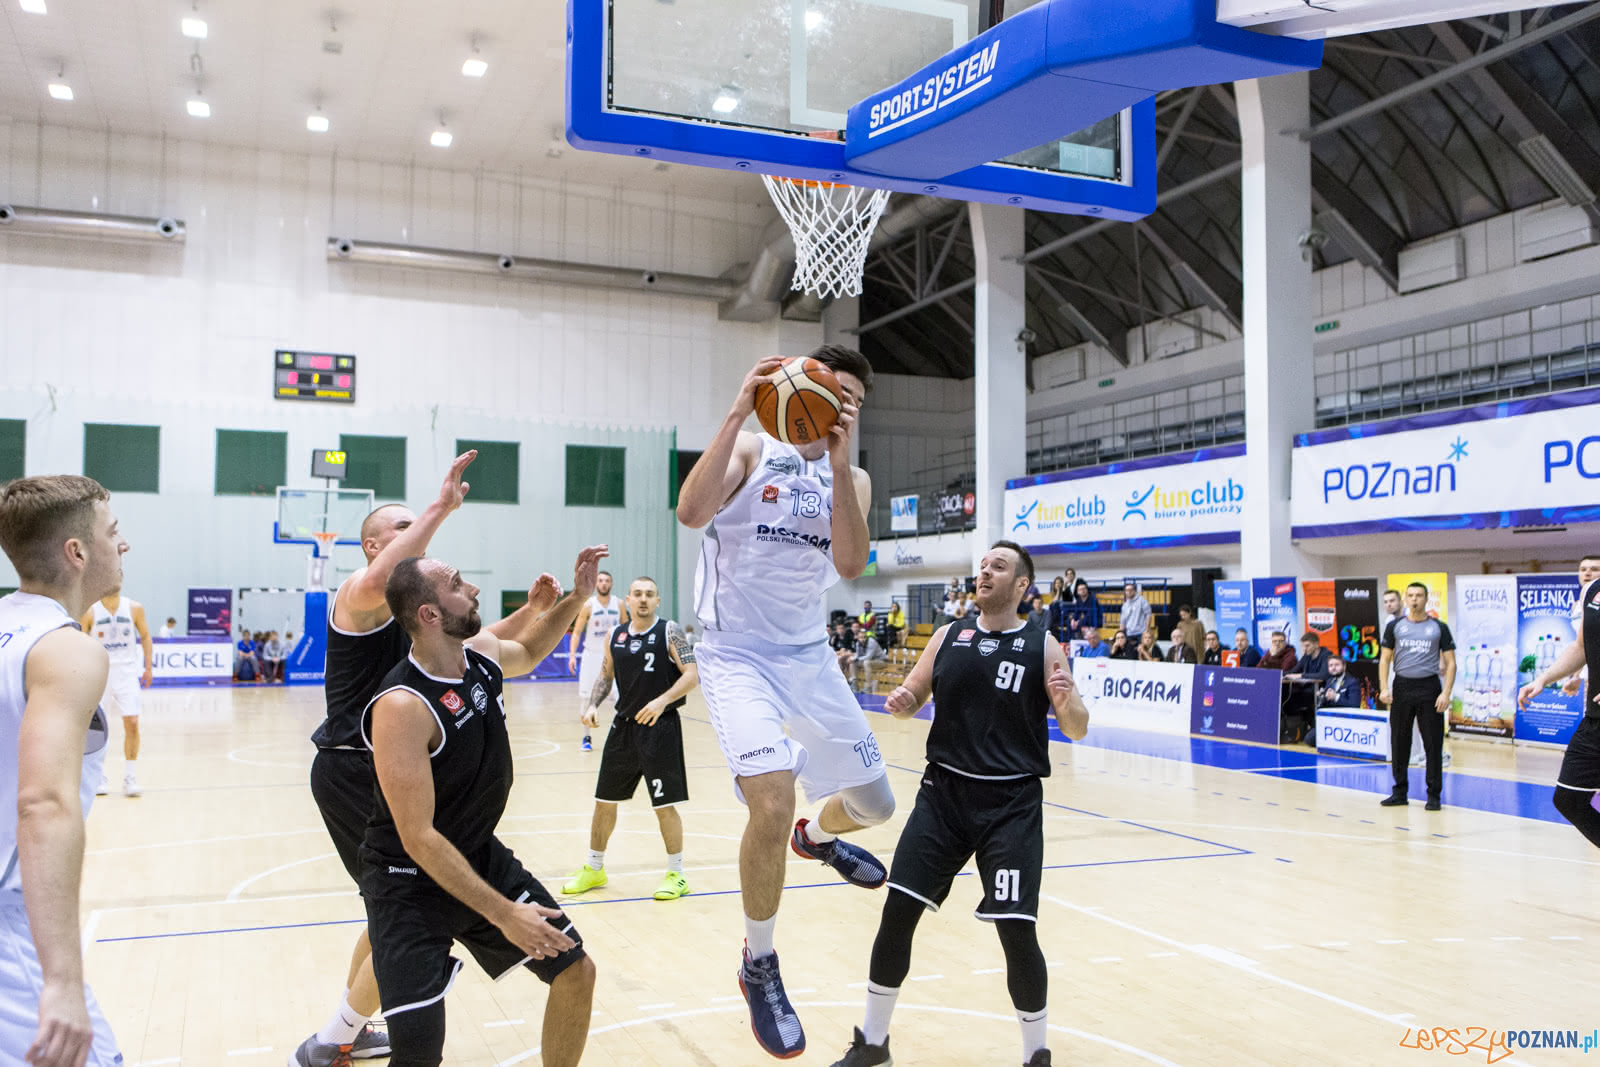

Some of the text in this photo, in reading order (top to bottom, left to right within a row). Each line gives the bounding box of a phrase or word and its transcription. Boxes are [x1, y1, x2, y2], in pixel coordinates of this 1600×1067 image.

[790, 488, 822, 518] 13
[1154, 509, 1186, 519] biuro
[1037, 521, 1061, 530] biuro
[756, 535, 780, 543] POLSKI
[1465, 588, 1509, 605] SELENKA
[1520, 590, 1576, 611] SELENKA
[644, 652, 656, 672] 2
[1225, 653, 1238, 668] 5
[995, 661, 1026, 693] 91
[1103, 677, 1184, 705] BIOFARM
[740, 747, 776, 761] macron
[853, 732, 881, 768] 13
[652, 778, 664, 798] 2
[388, 866, 417, 875] SPALDING
[995, 869, 1020, 902] 91
